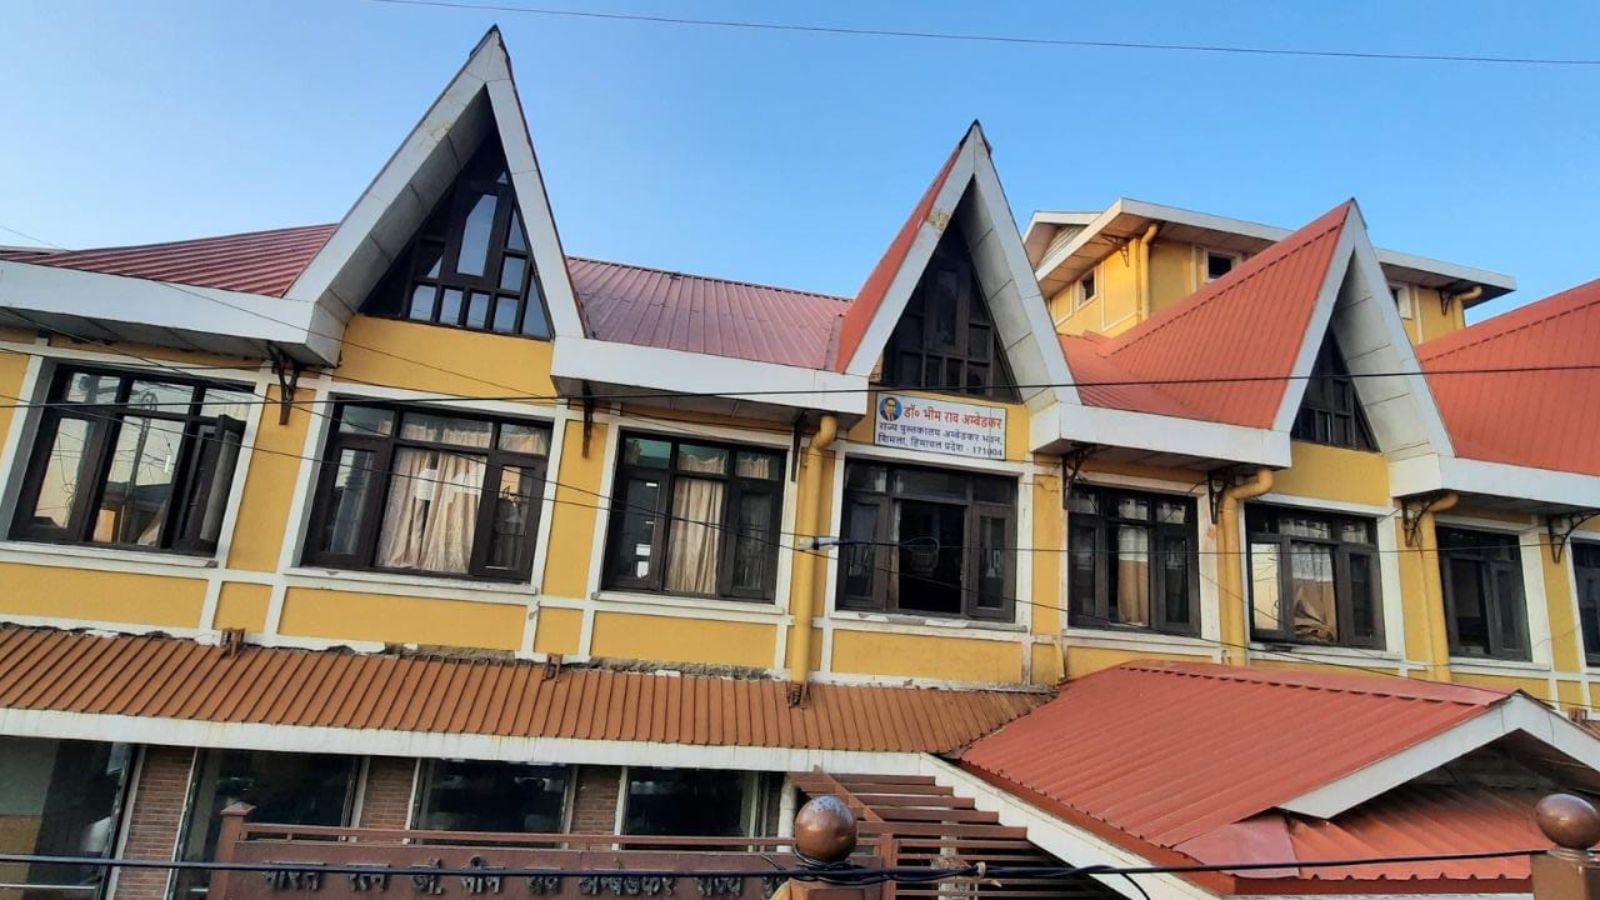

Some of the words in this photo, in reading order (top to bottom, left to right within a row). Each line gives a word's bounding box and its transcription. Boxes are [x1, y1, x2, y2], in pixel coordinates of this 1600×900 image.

[923, 406, 941, 421] भीम
[945, 411, 959, 423] राव
[962, 412, 1002, 429] अम्बेडकर
[879, 422, 898, 432] राज्य
[901, 424, 940, 437] पुस्तकालय
[911, 438, 942, 449] हिमाचल
[973, 447, 1002, 457] 171004
